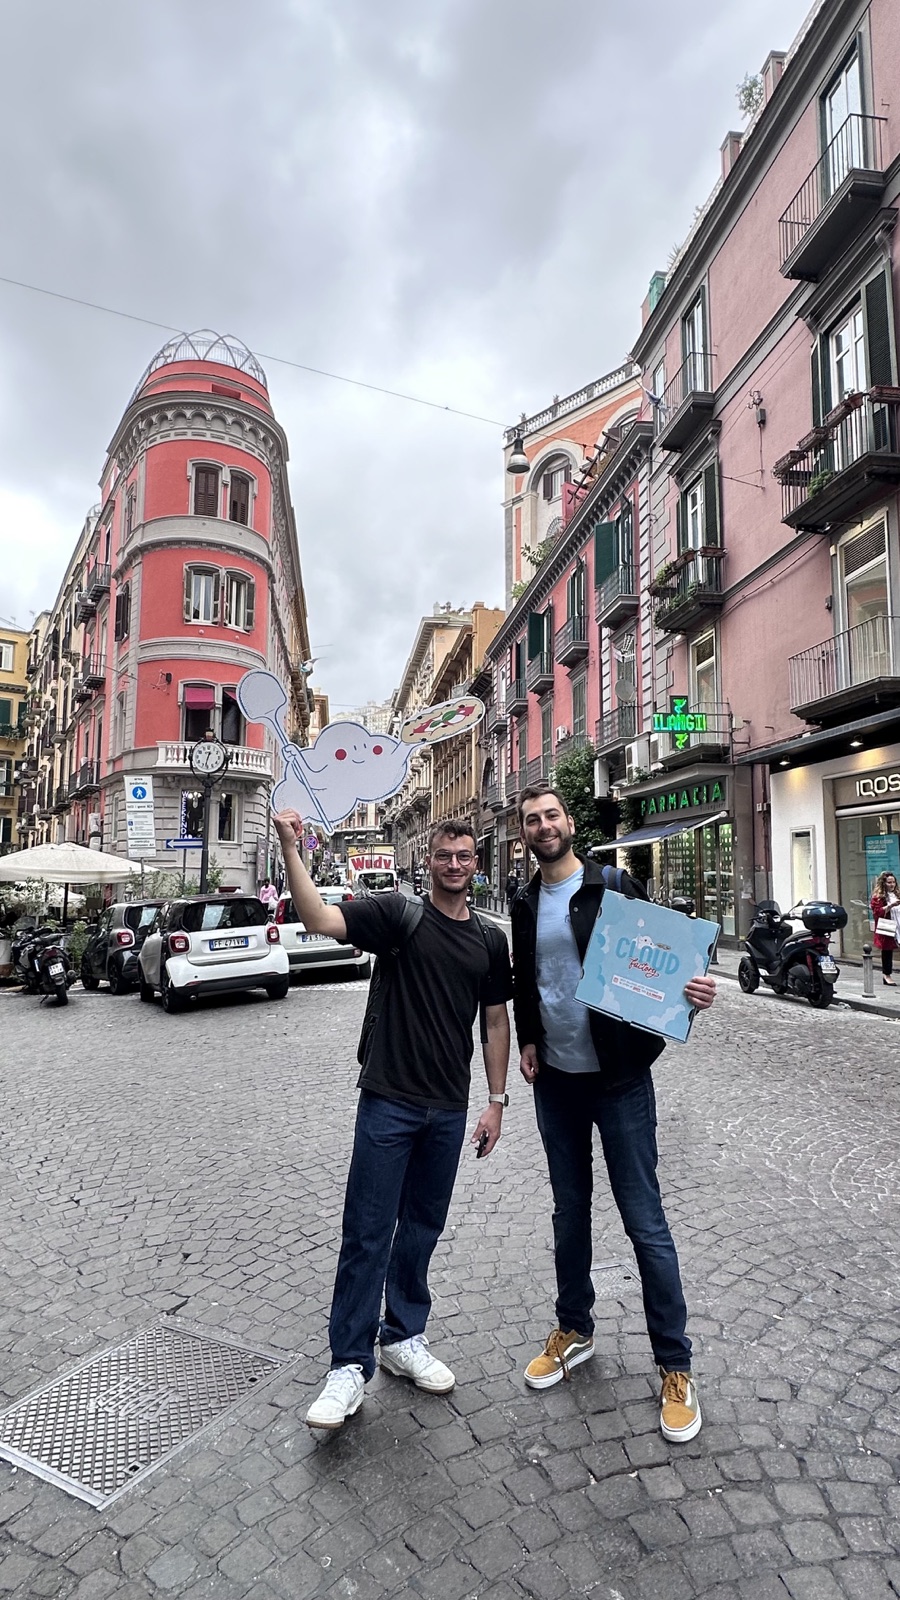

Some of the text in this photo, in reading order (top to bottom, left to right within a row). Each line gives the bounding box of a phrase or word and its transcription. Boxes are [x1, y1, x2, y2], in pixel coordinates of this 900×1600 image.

[641, 782, 723, 816] FARMACIA
[856, 773, 900, 797] IQOS
[615, 937, 680, 975] CLOUD
